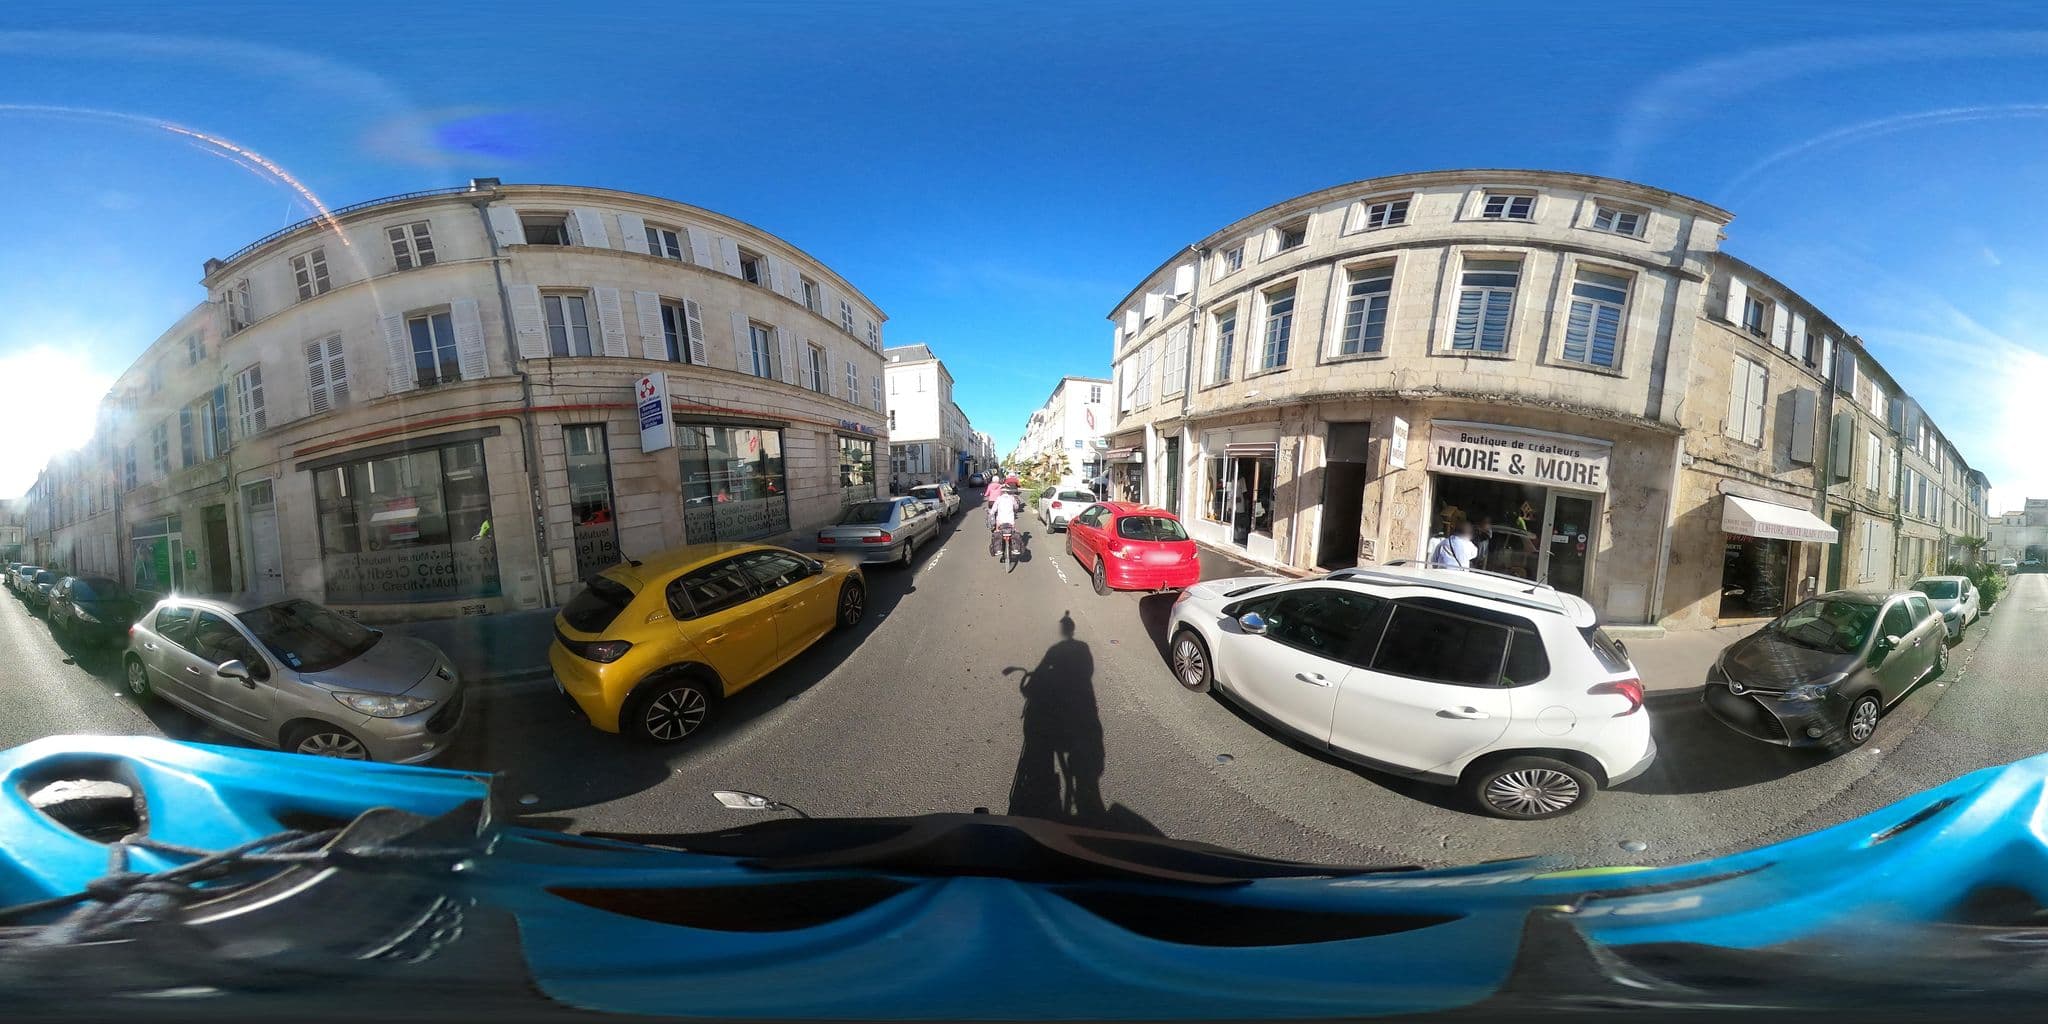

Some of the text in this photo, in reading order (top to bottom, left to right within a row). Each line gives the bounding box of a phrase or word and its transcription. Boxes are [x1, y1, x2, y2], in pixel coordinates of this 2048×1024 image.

[1460, 433, 1580, 458] Boutique de créateurs
[1437, 446, 1601, 486] MORE & MORE
